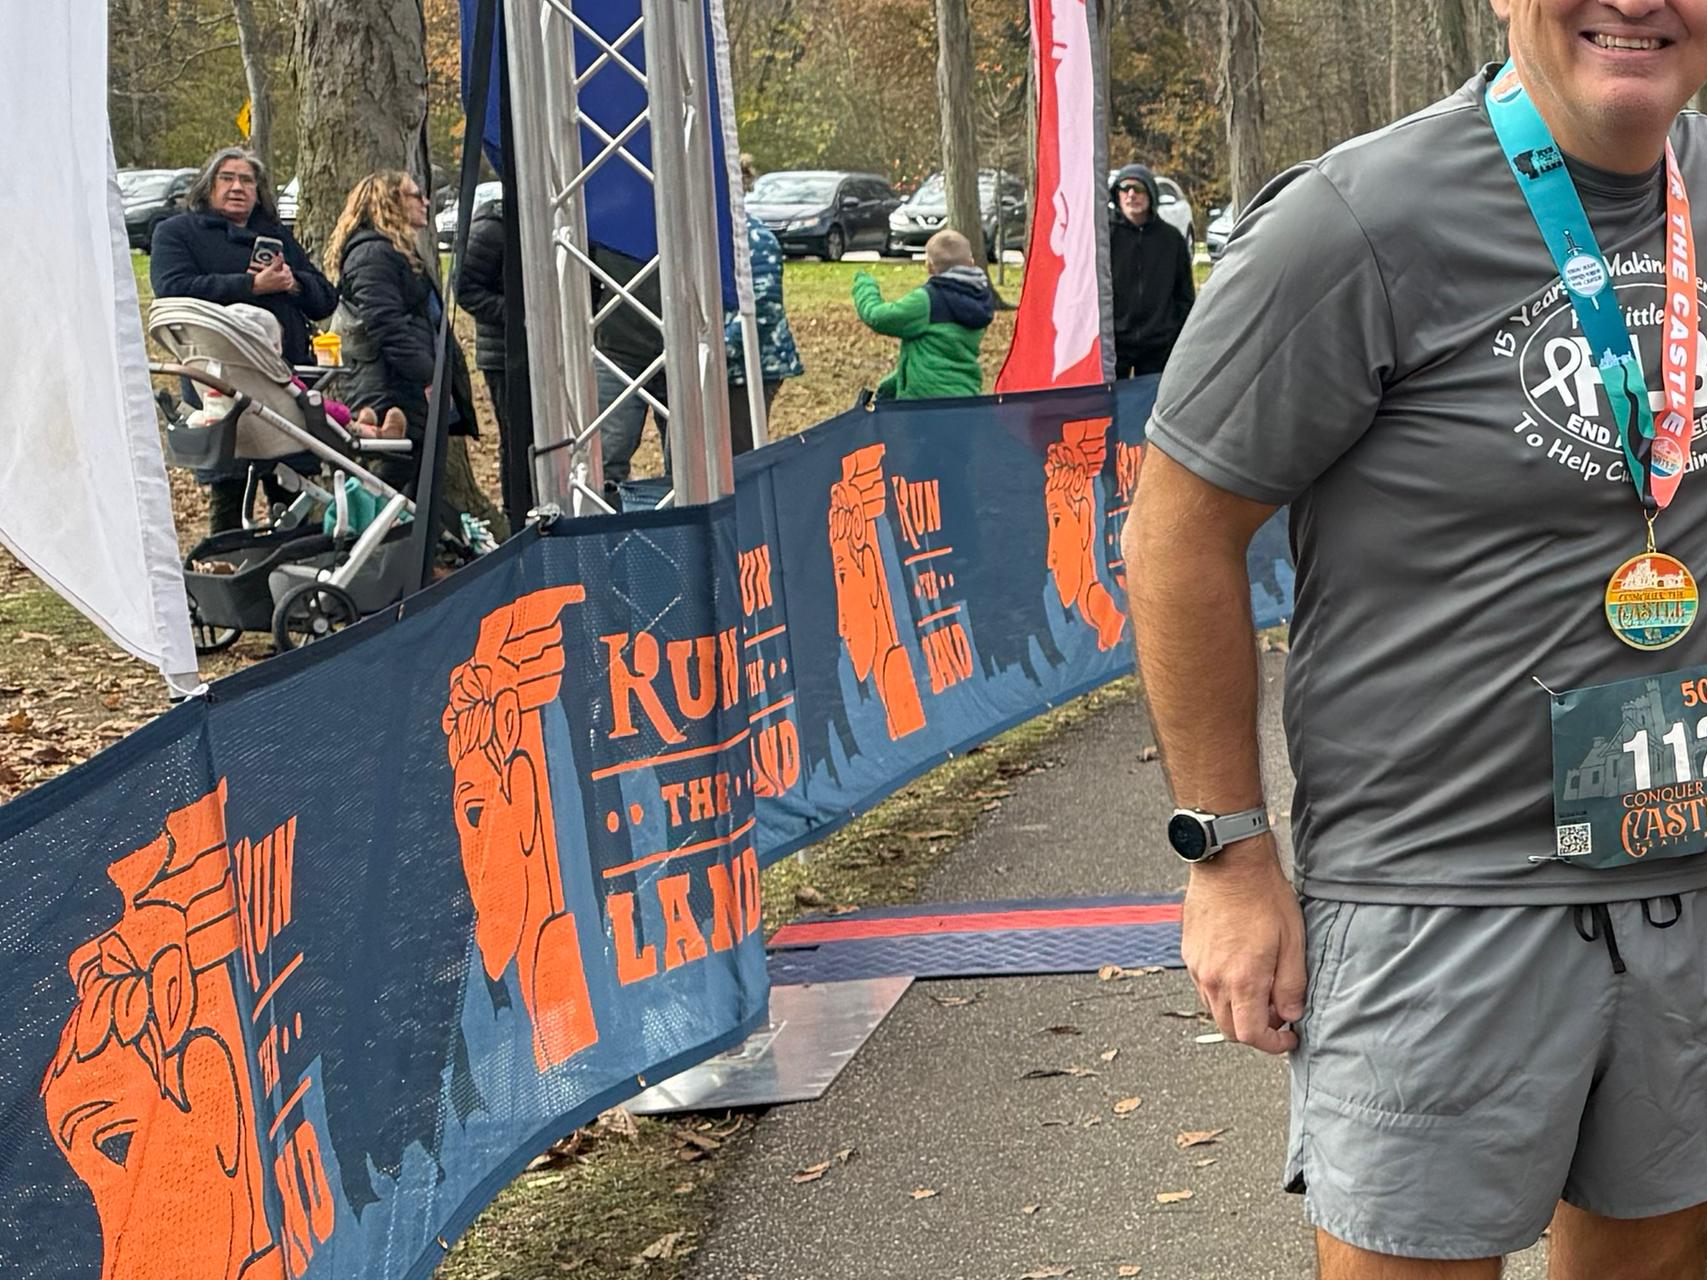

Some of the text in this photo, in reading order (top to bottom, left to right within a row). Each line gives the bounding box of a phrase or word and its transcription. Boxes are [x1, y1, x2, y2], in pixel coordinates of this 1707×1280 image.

[1672, 215, 1689, 283] THE
[1493, 330, 1516, 357] 15
[1603, 251, 1667, 278] Makin
[1619, 302, 1665, 327] ittle
[1661, 292, 1690, 437] CASTLE
[1513, 410, 1544, 447] To
[1547, 438, 1601, 481] Help
[1566, 413, 1611, 444] END
[891, 475, 942, 549] RUN
[738, 544, 773, 617] UN
[600, 627, 739, 744] RUN
[746, 658, 766, 698] HE
[661, 771, 731, 827] THE
[1622, 780, 1705, 809] CONQUER
[234, 816, 297, 993] RUN
[607, 848, 760, 987] LAND
